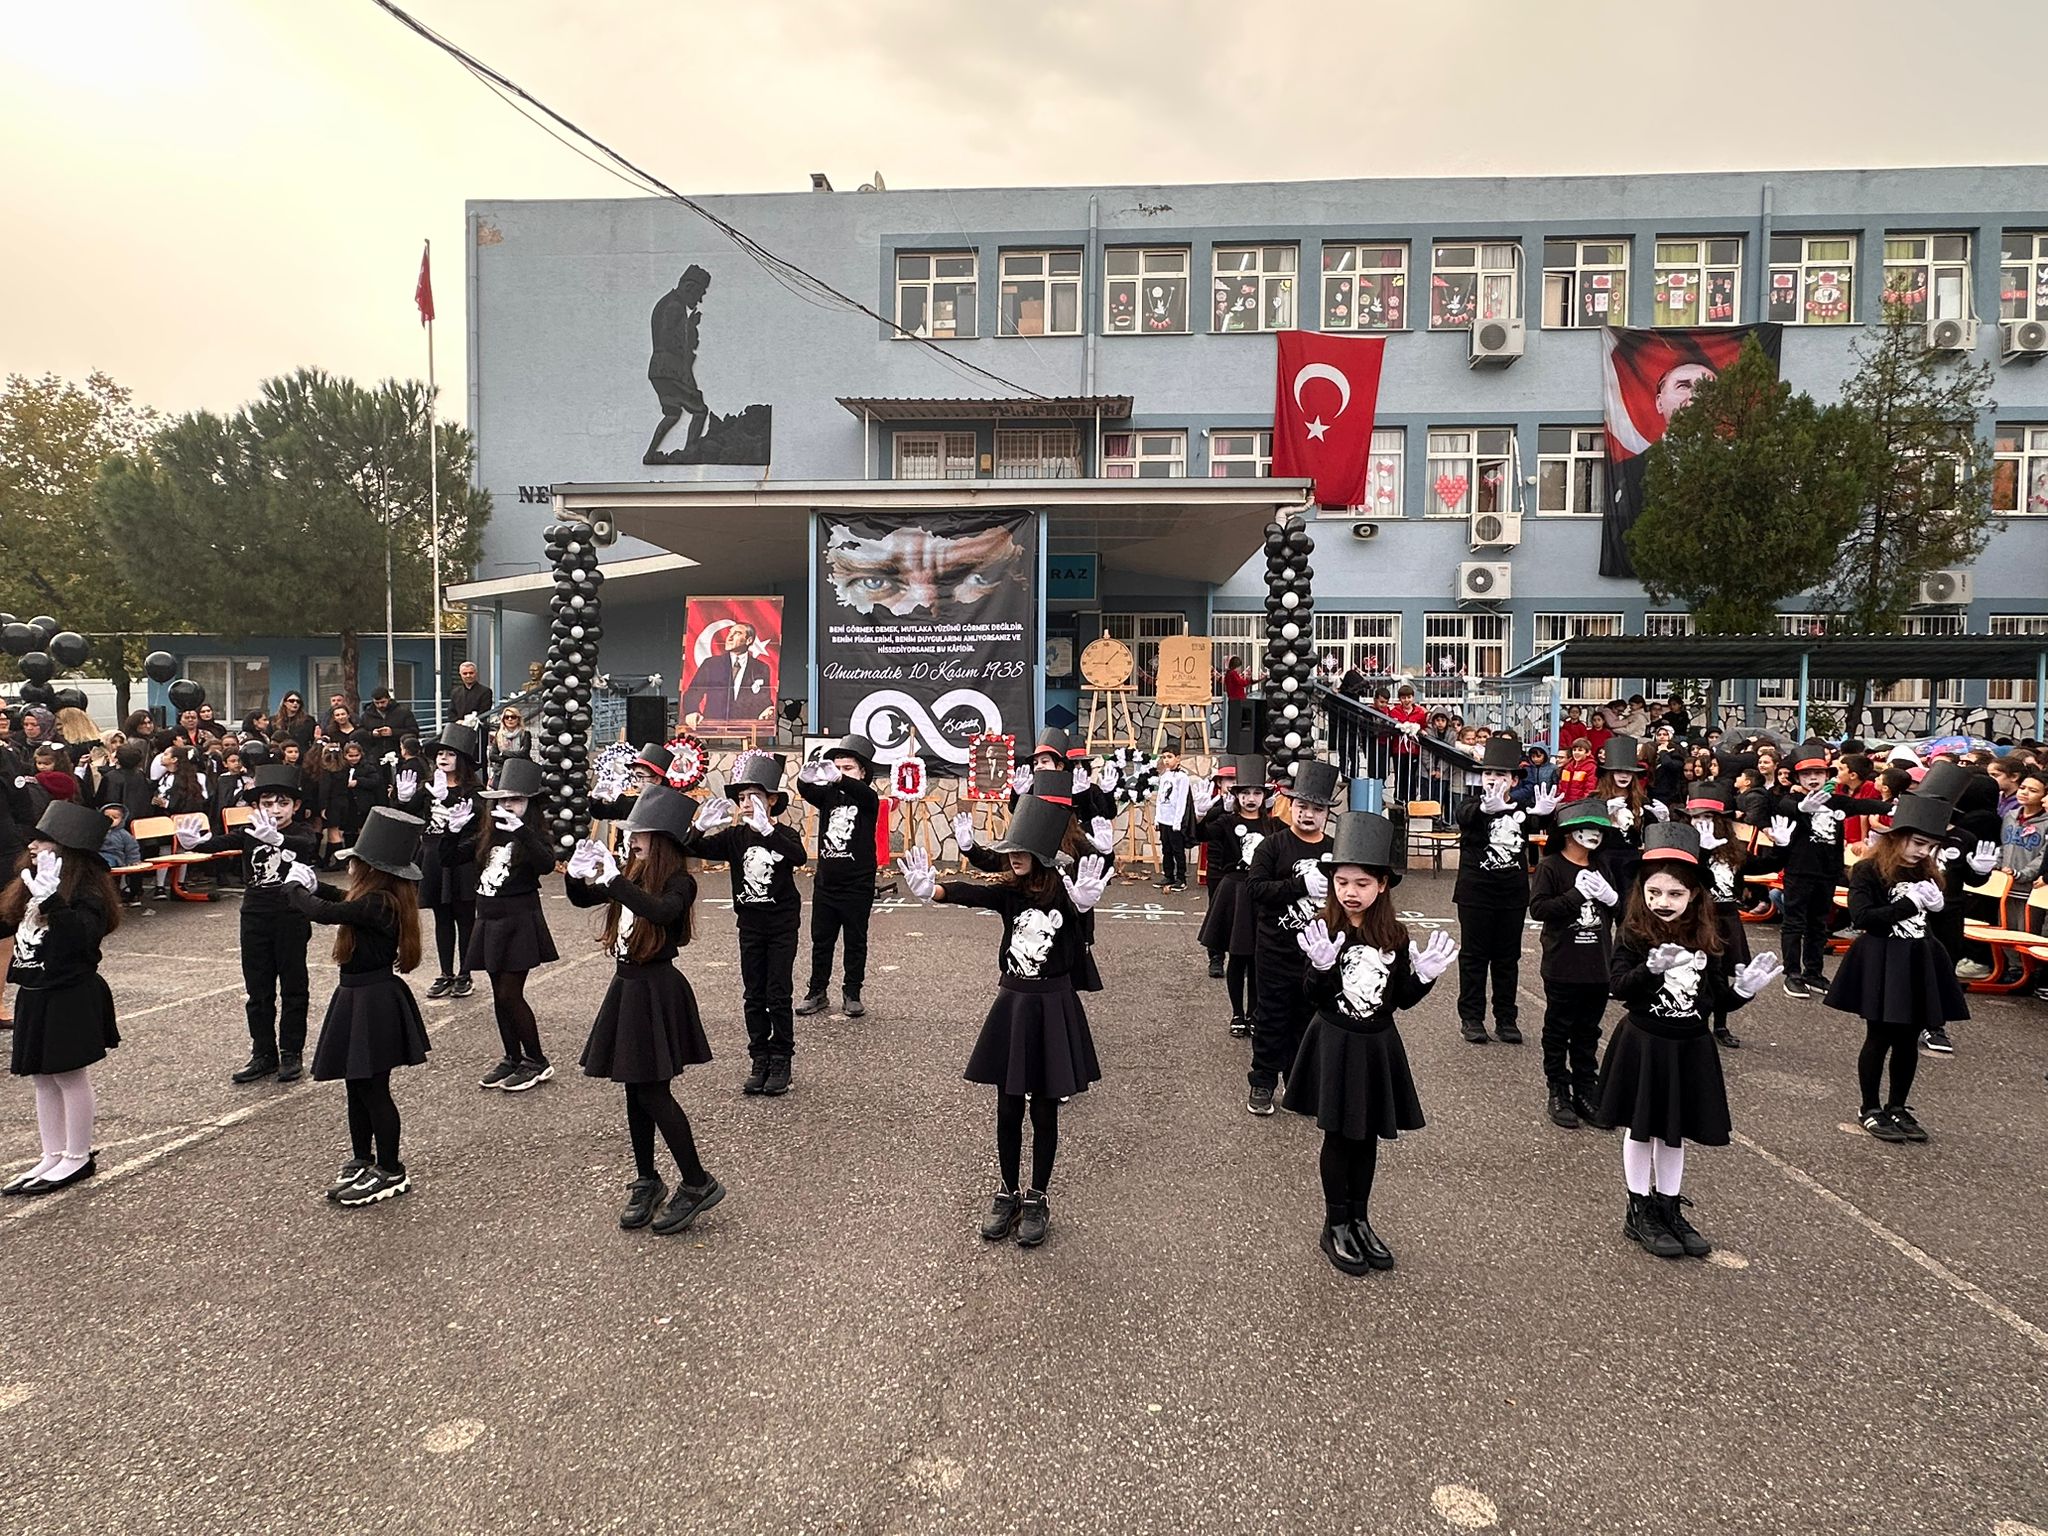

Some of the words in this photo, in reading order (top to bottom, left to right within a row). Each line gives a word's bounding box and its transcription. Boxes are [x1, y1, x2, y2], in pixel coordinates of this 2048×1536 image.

[901, 625, 932, 633] MUTLAKA
[823, 662, 903, 680] Unutmadık
[908, 662, 929, 679] 10
[930, 660, 979, 681] Kasım
[981, 661, 1026, 680] 1938
[1172, 656, 1196, 674] 10
